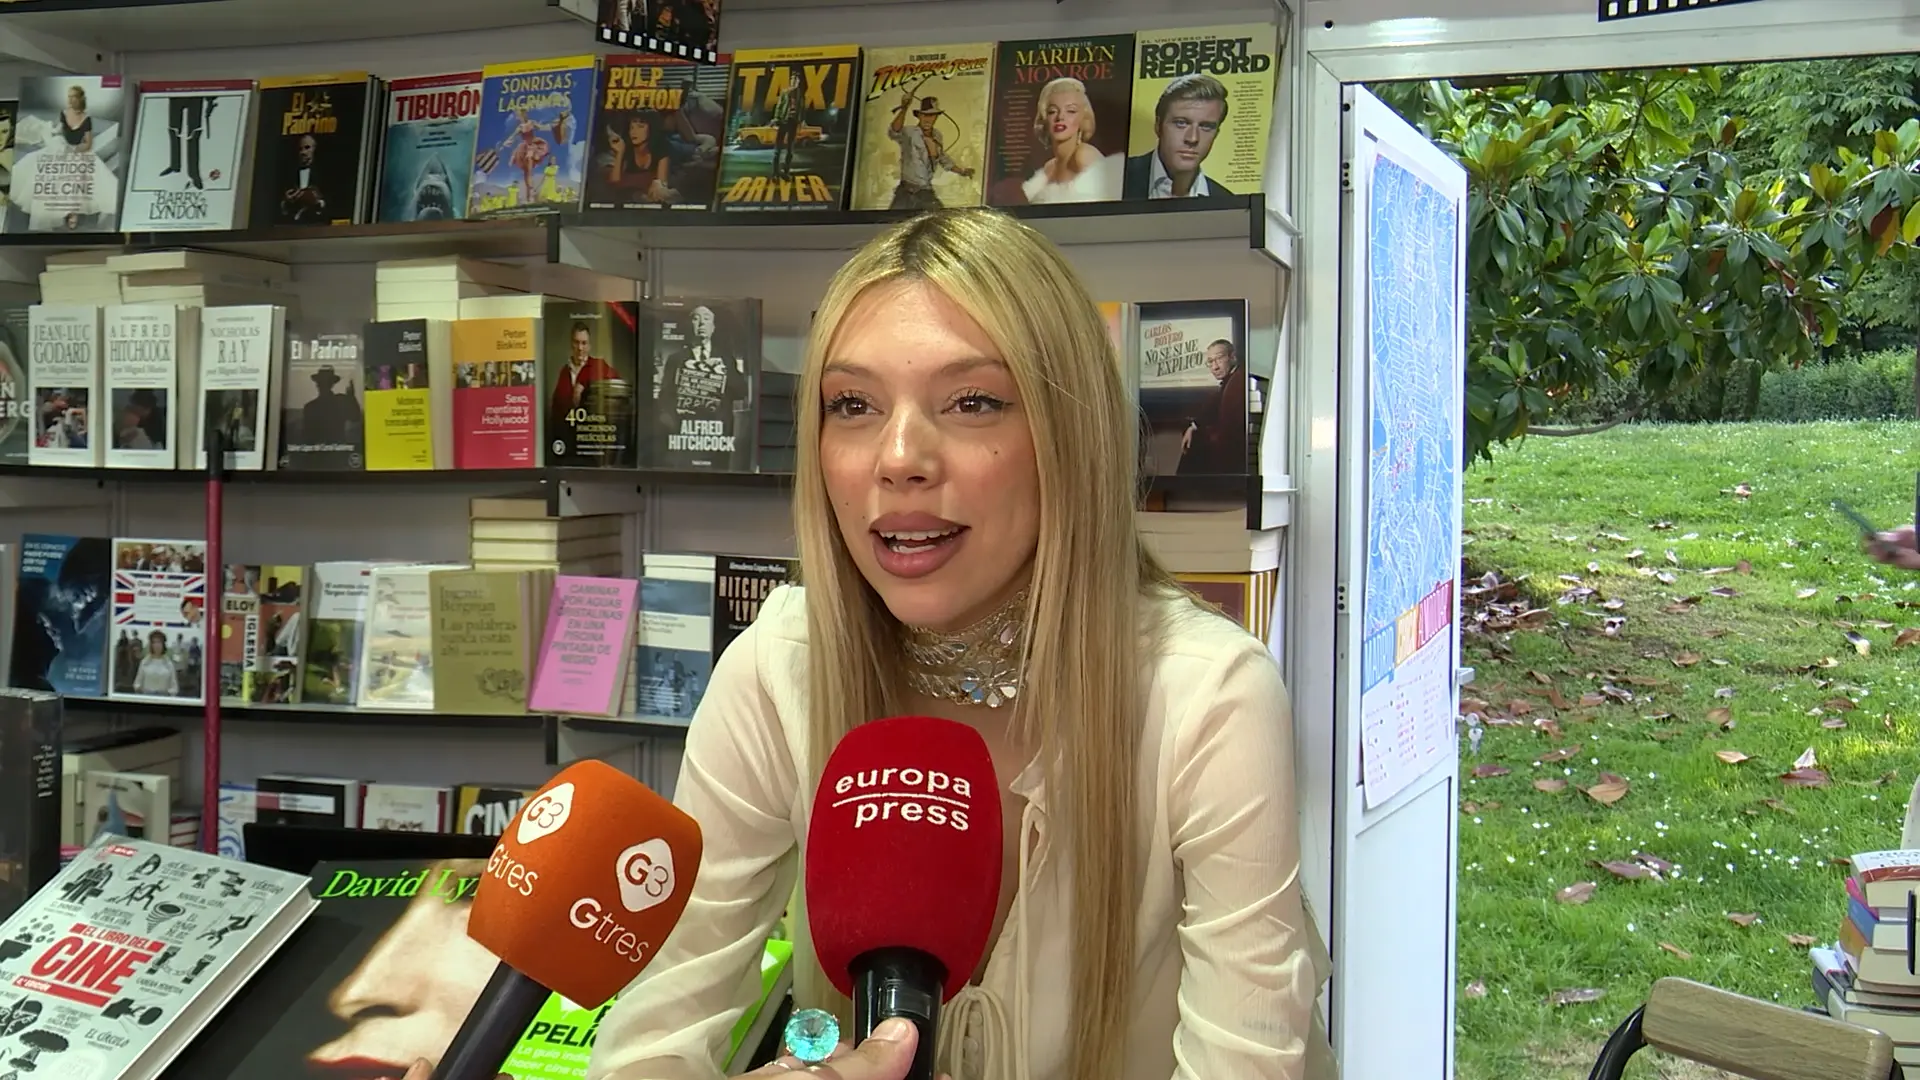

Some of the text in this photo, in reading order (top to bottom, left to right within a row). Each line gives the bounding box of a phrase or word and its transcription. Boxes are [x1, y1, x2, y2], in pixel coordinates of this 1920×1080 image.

[1014, 45, 1115, 67] MARILYN
[1141, 37, 1253, 62] ROBERT
[608, 67, 664, 88] PULP
[1014, 63, 1114, 84] MONROE
[1139, 54, 1271, 80] REDFORD
[501, 73, 572, 94] SONRISAS
[738, 63, 851, 114] TAXI
[866, 59, 950, 102] INDIANA
[292, 93, 305, 112] El
[605, 88, 684, 110] FICTION
[281, 112, 338, 136] Padrino
[37, 163, 96, 174] VESTIDOS
[34, 182, 94, 195] DEL CINE
[154, 190, 201, 206] BARRY
[721, 174, 835, 203] DRIVER
[149, 203, 207, 220] LYNDON
[34, 324, 91, 341] JEAN-LUC
[109, 323, 172, 338] ALFRED
[210, 326, 261, 337] NICHOLAS
[503, 329, 527, 339] Peter
[1144, 322, 1172, 340] CARLOS
[33, 341, 91, 363] GODARD
[109, 340, 171, 362] HITCHCOCK
[217, 339, 250, 363] RAY
[291, 340, 357, 359] El Padrino
[496, 340, 527, 351] Biskind
[1183, 338, 1199, 354] ME
[1156, 350, 1204, 378] EXPLICO
[481, 415, 530, 427] Hollywood
[565, 407, 587, 426] 40
[680, 420, 723, 436] ALFRED
[668, 435, 736, 452] HITCHCOCK
[226, 600, 255, 611] ELOY
[246, 617, 257, 668] IGLESIA
[561, 653, 598, 666] NEGRO
[835, 767, 972, 799] europa
[527, 796, 565, 829] G3
[854, 801, 969, 831] press
[487, 843, 540, 897] Gtres
[624, 853, 669, 897] G3
[317, 869, 428, 899] David
[82, 925, 151, 950] EL LIBRO DEL
[569, 898, 650, 963] Gtres
[31, 935, 153, 994] CINE
[543, 1062, 570, 1074] cine
